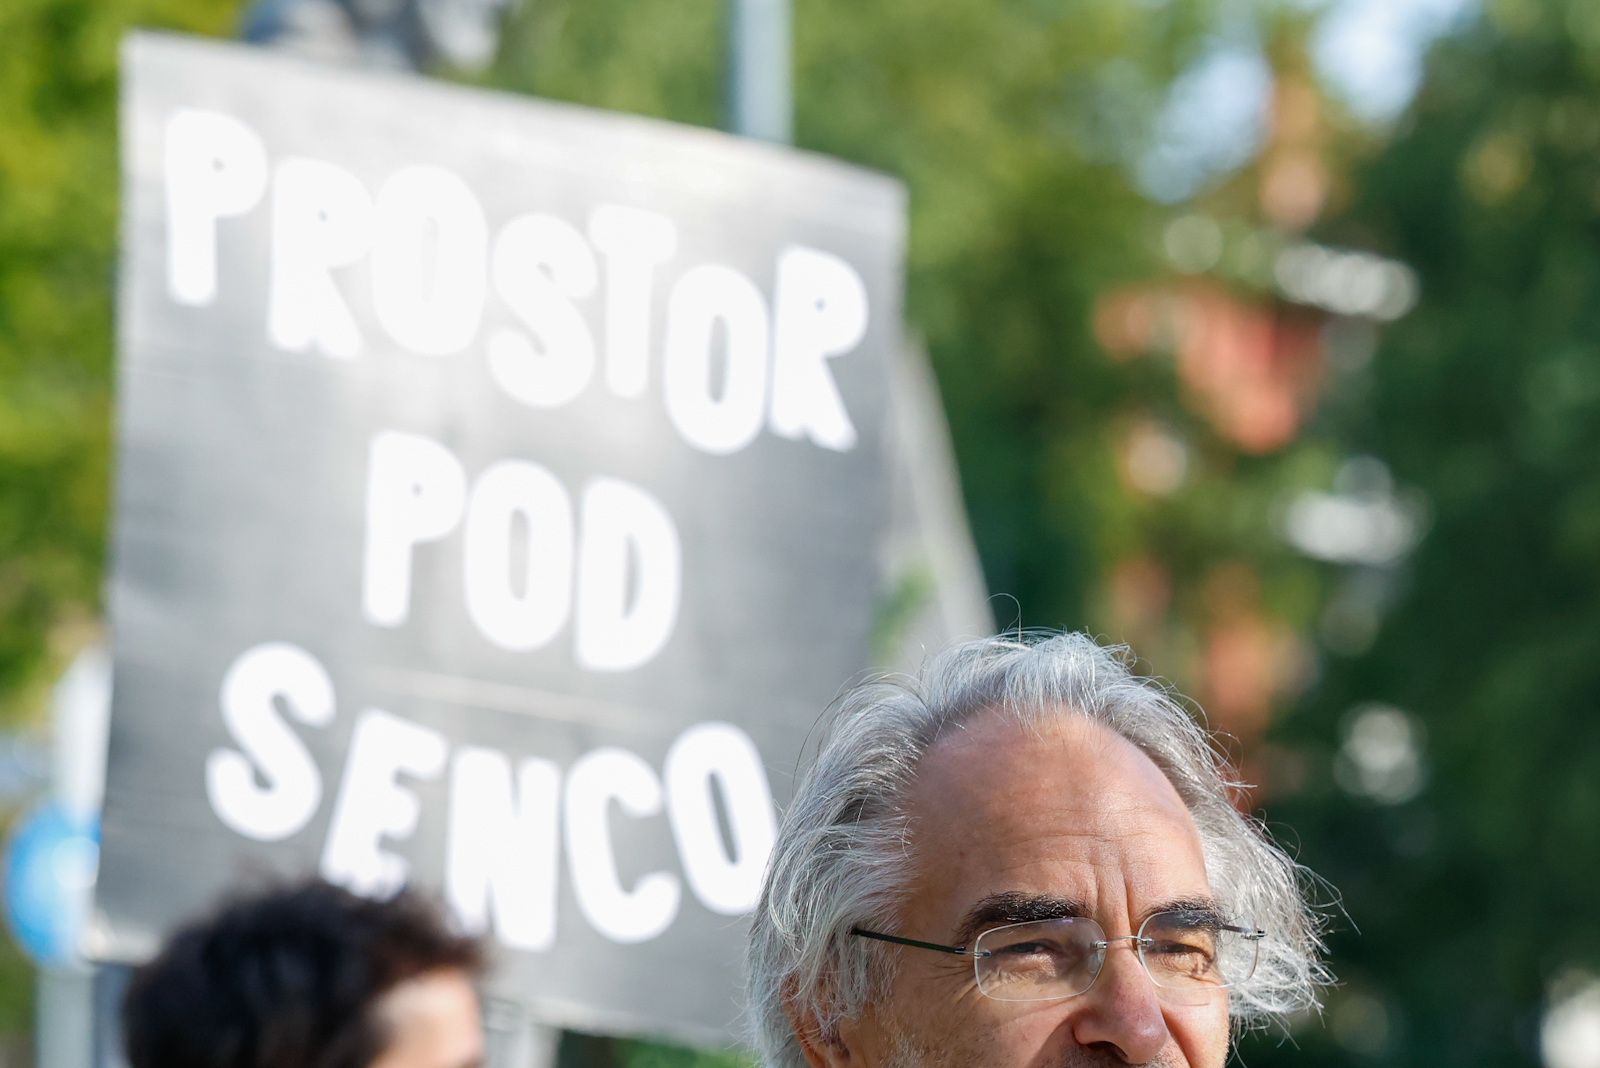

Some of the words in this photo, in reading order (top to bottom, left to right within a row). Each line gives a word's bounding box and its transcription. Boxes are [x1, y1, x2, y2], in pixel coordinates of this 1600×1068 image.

[164, 106, 869, 456] PROSTOR
[361, 430, 682, 673] POD
[205, 641, 782, 953] SENCO
